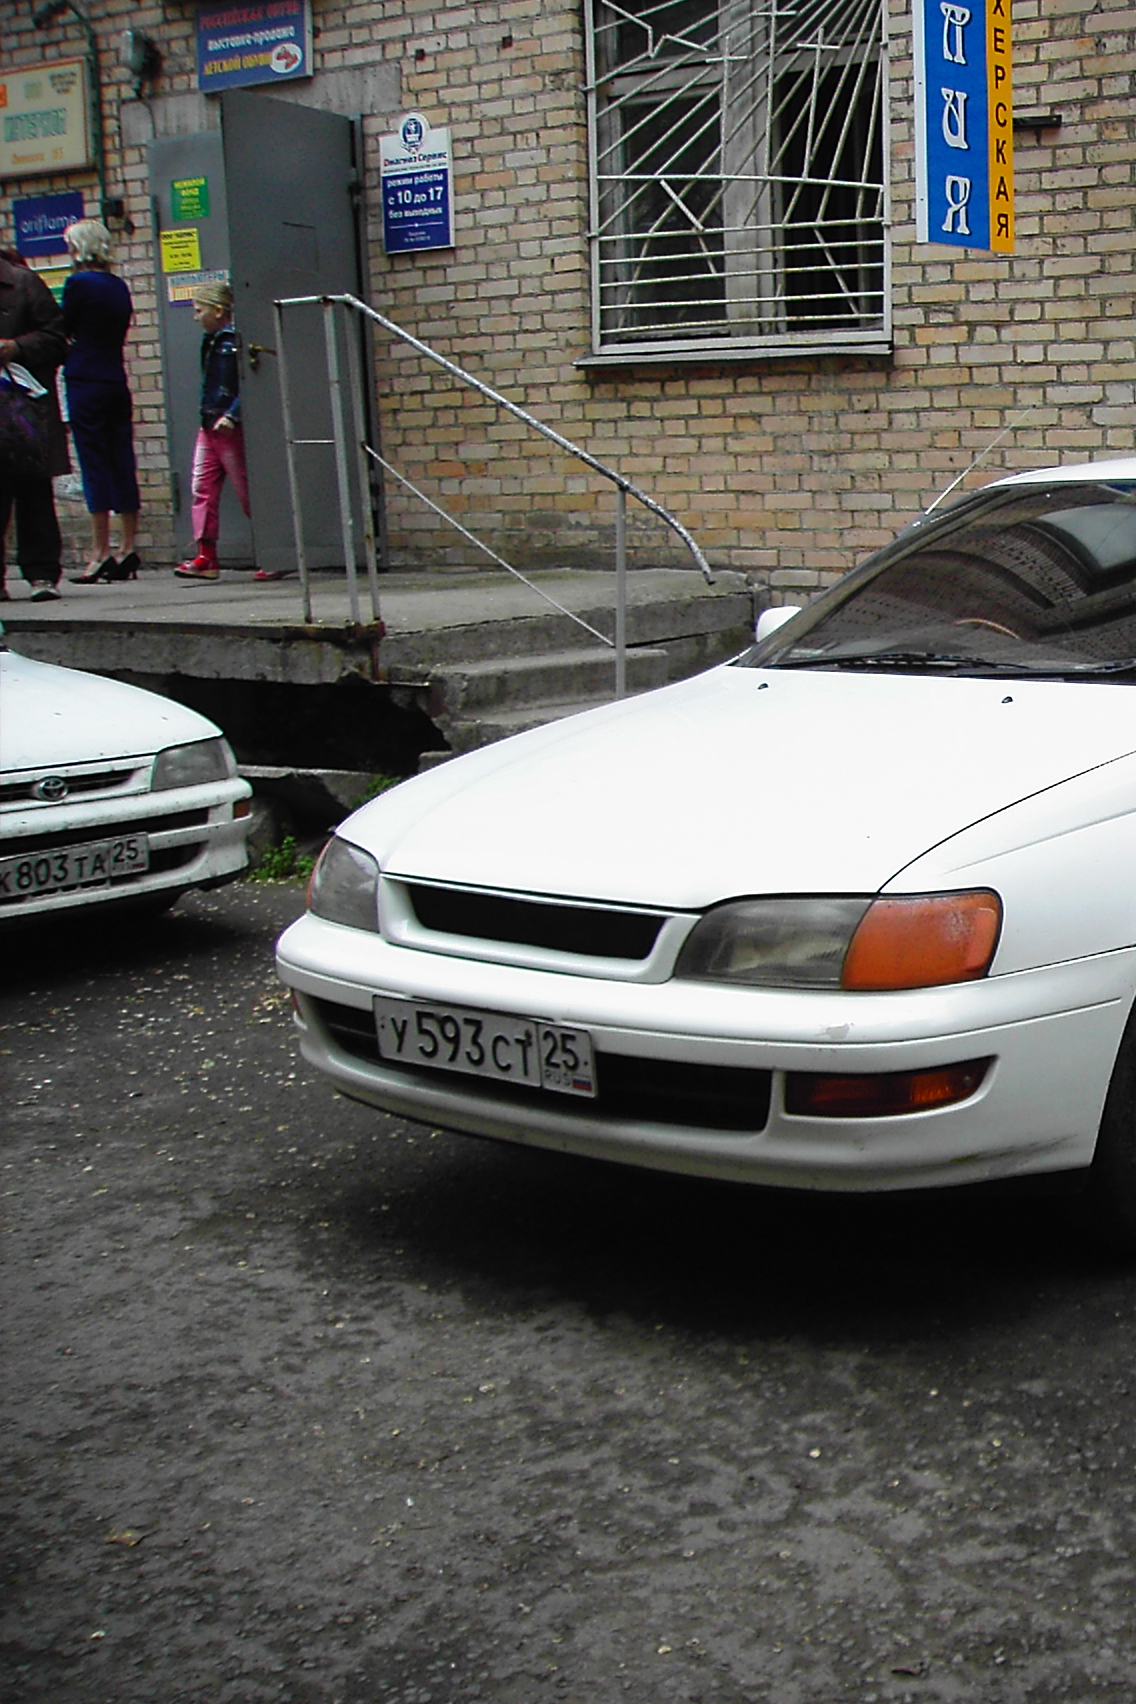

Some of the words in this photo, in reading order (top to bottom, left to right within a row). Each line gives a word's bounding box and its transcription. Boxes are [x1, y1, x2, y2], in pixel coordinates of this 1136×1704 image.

[397, 189, 412, 204] 10
[413, 193, 427, 204] до
[428, 186, 443, 202] 17
[21, 213, 78, 234] oriflame
[113, 839, 139, 863] 25
[543, 1030, 579, 1071] 25
